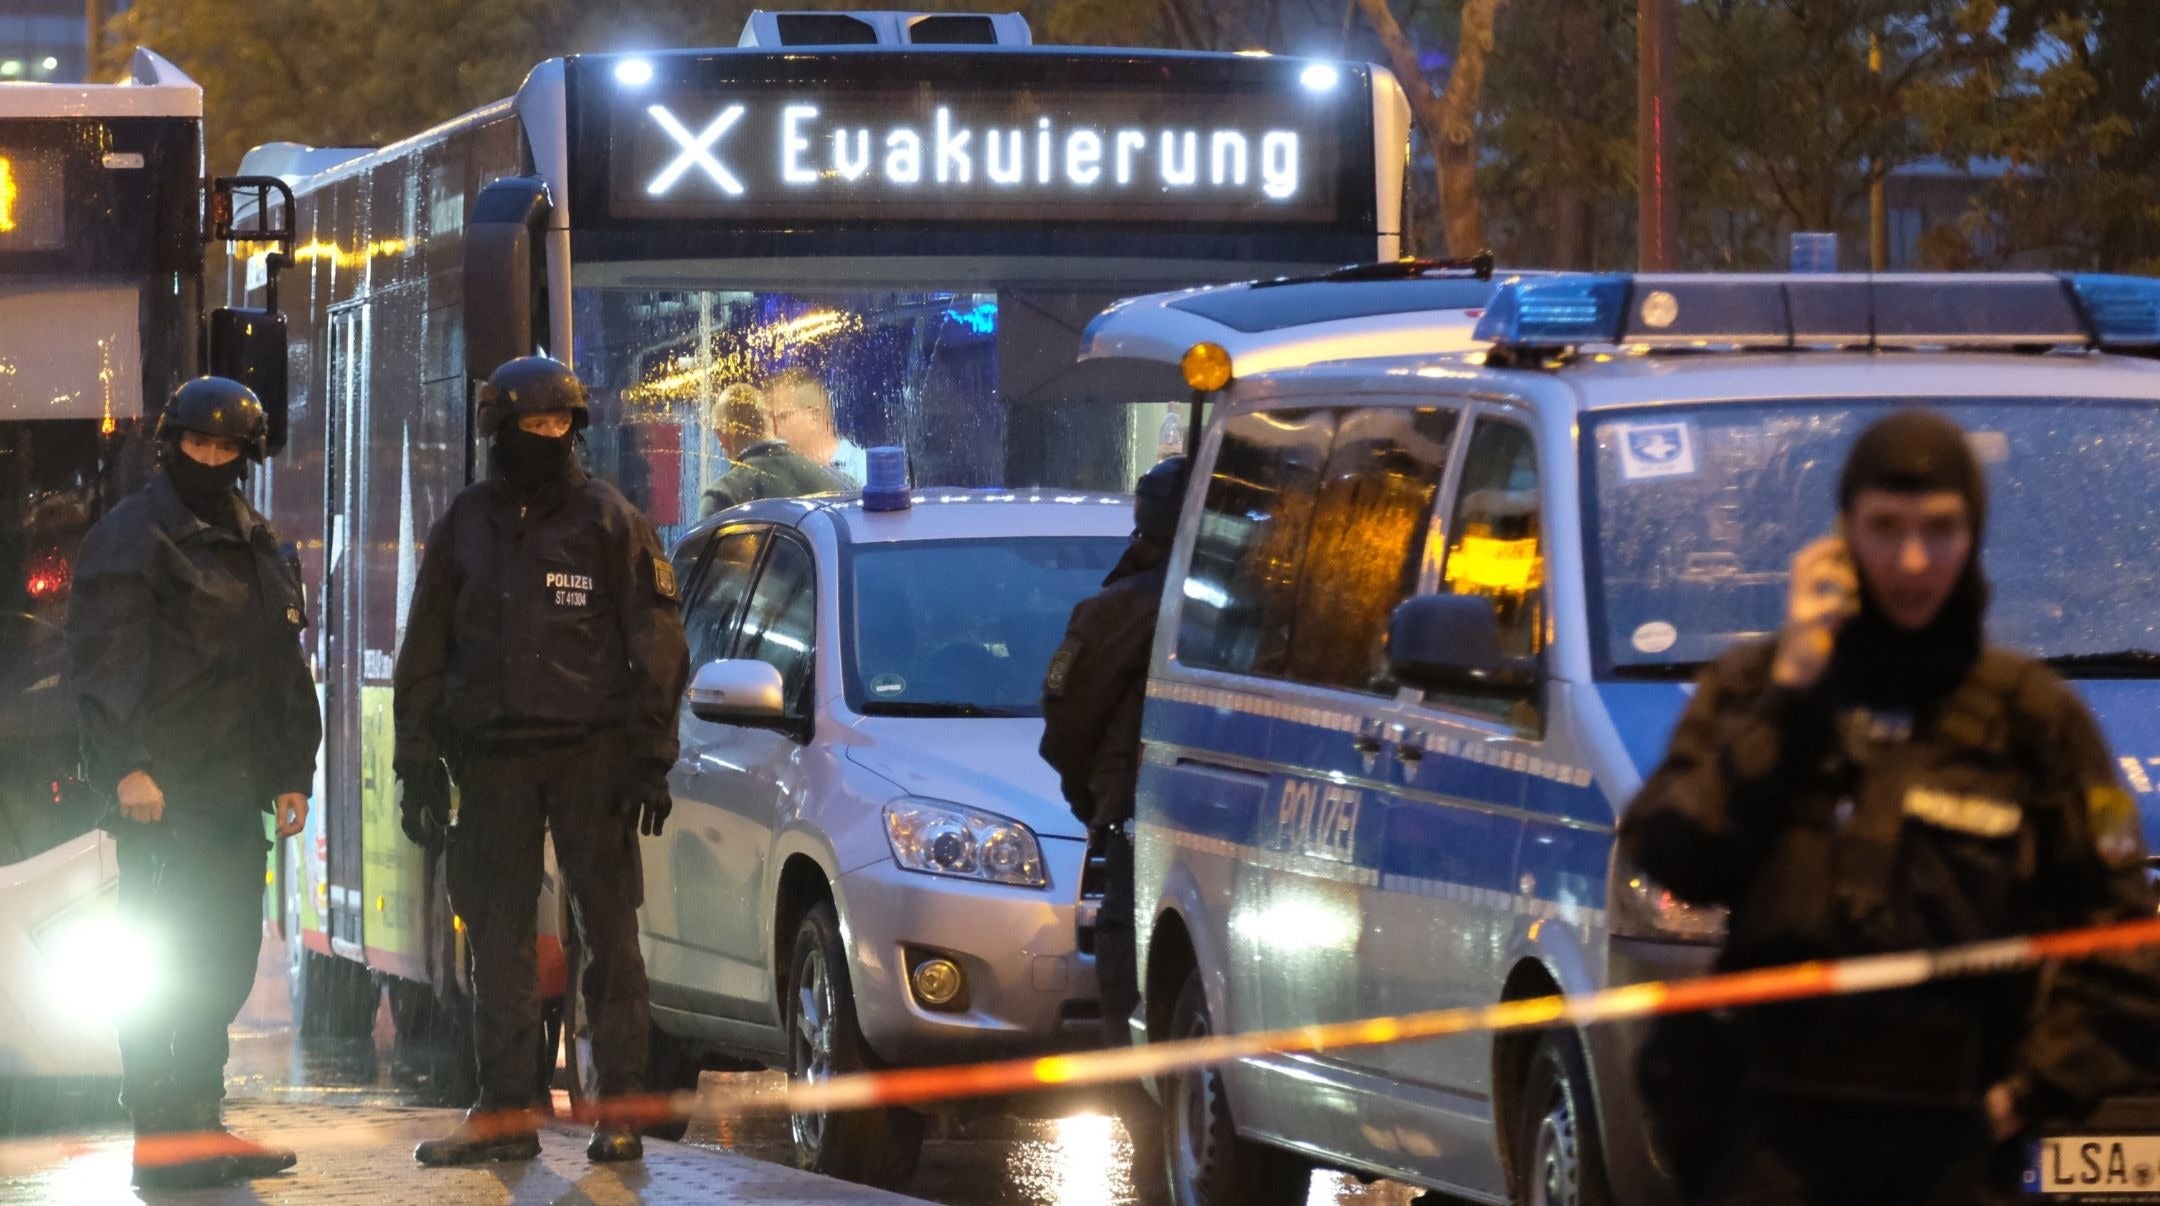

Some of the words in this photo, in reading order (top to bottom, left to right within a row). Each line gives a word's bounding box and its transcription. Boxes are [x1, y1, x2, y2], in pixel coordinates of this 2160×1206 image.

[782, 105, 1300, 197] Evakuierung
[546, 573, 593, 590] POLIZEI
[555, 590, 566, 605] ST
[1279, 779, 1361, 863] POLIZEI
[2053, 1142, 2128, 1185] LSA
